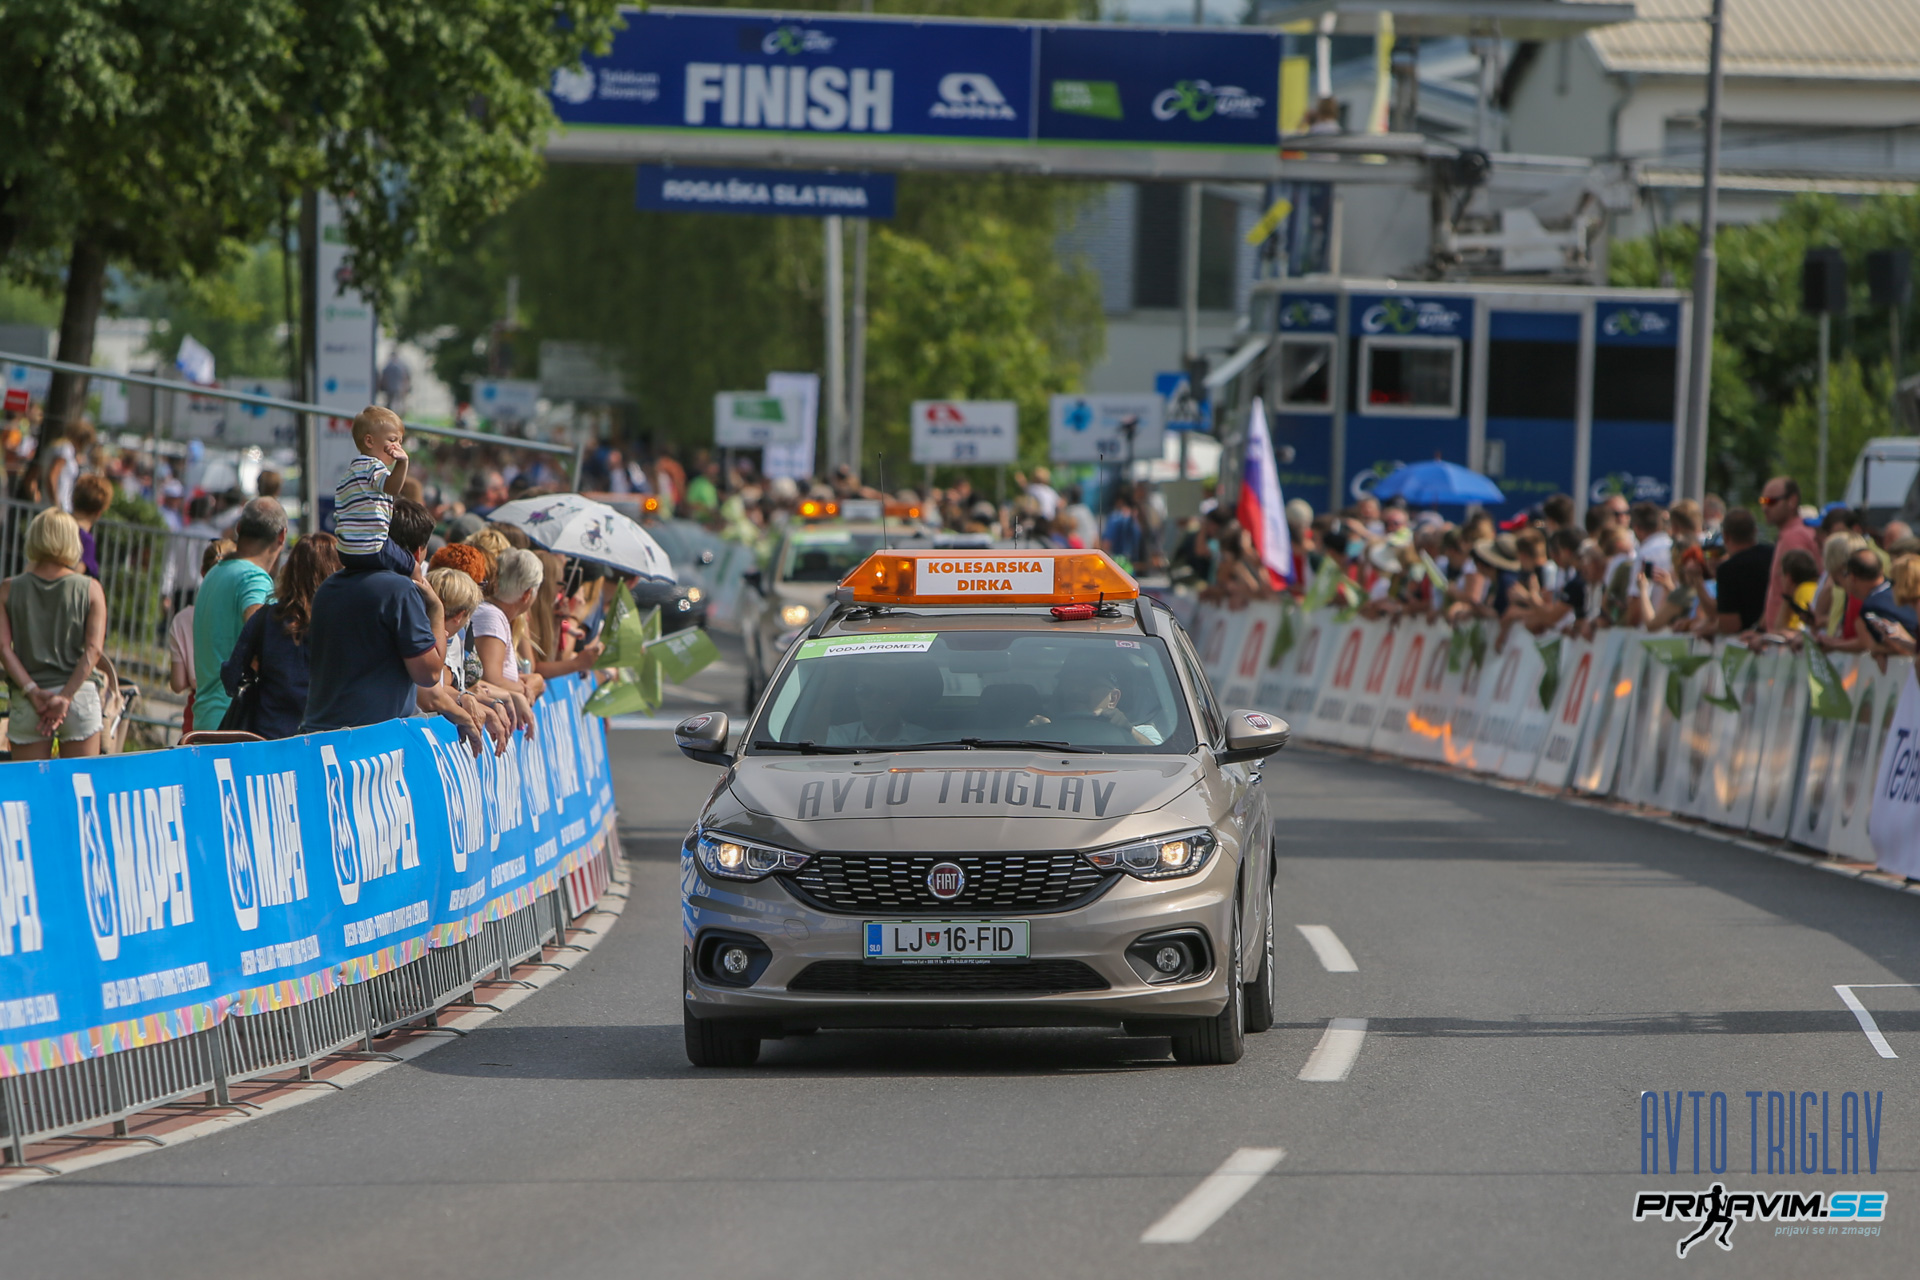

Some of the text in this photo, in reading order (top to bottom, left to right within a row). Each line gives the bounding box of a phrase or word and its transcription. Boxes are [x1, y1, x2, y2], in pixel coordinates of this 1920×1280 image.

[684, 62, 894, 131] FINISH
[662, 178, 868, 208] ROGAŠKA SLATINA
[928, 562, 1043, 573] KOLESARSKA
[957, 579, 1013, 591] DIRKA
[829, 645, 865, 653] VODJA
[797, 770, 1116, 819] AVTO TRIGLAV
[350, 749, 421, 883] MAPEI
[246, 770, 309, 908] MAPEI
[108, 784, 195, 937] MAPEI
[936, 873, 957, 890] FIAT
[869, 944, 881, 953] SLO
[895, 927, 1013, 952] LJ 16-FID
